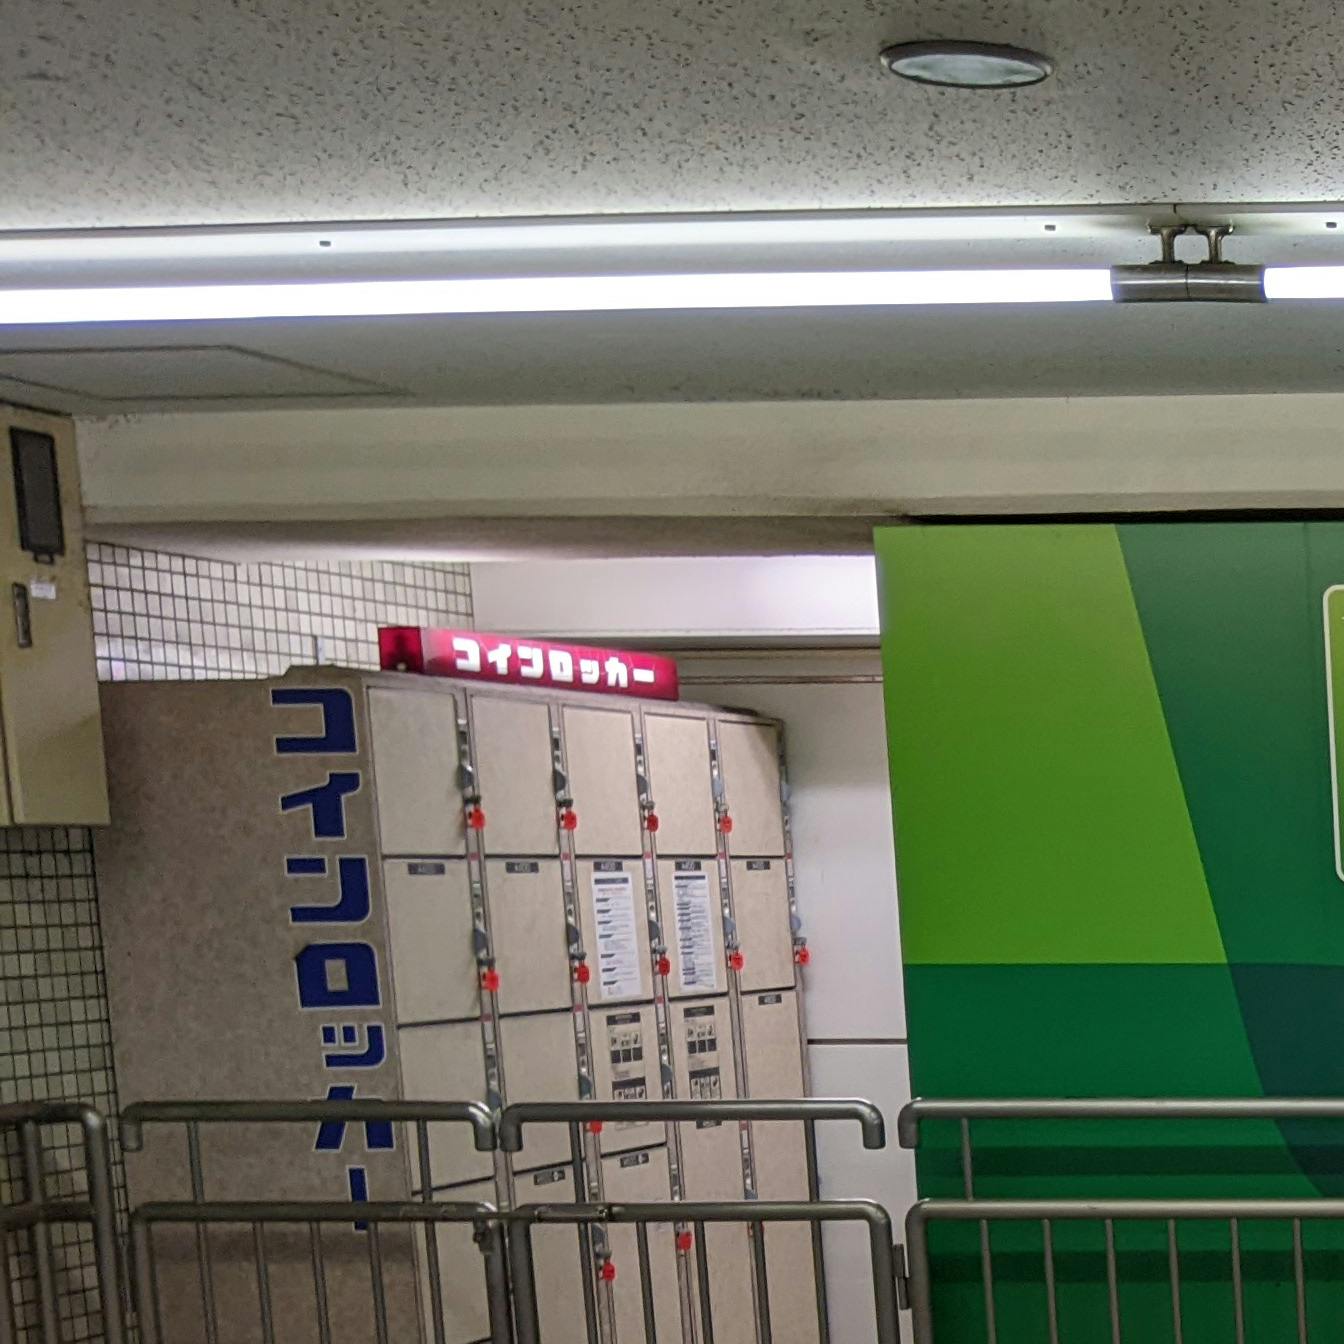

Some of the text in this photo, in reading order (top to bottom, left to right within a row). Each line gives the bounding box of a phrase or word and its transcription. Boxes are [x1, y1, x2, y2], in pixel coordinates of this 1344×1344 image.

[451, 636, 656, 689] コインロッカー
[270, 687, 396, 1231] コインロッカー
